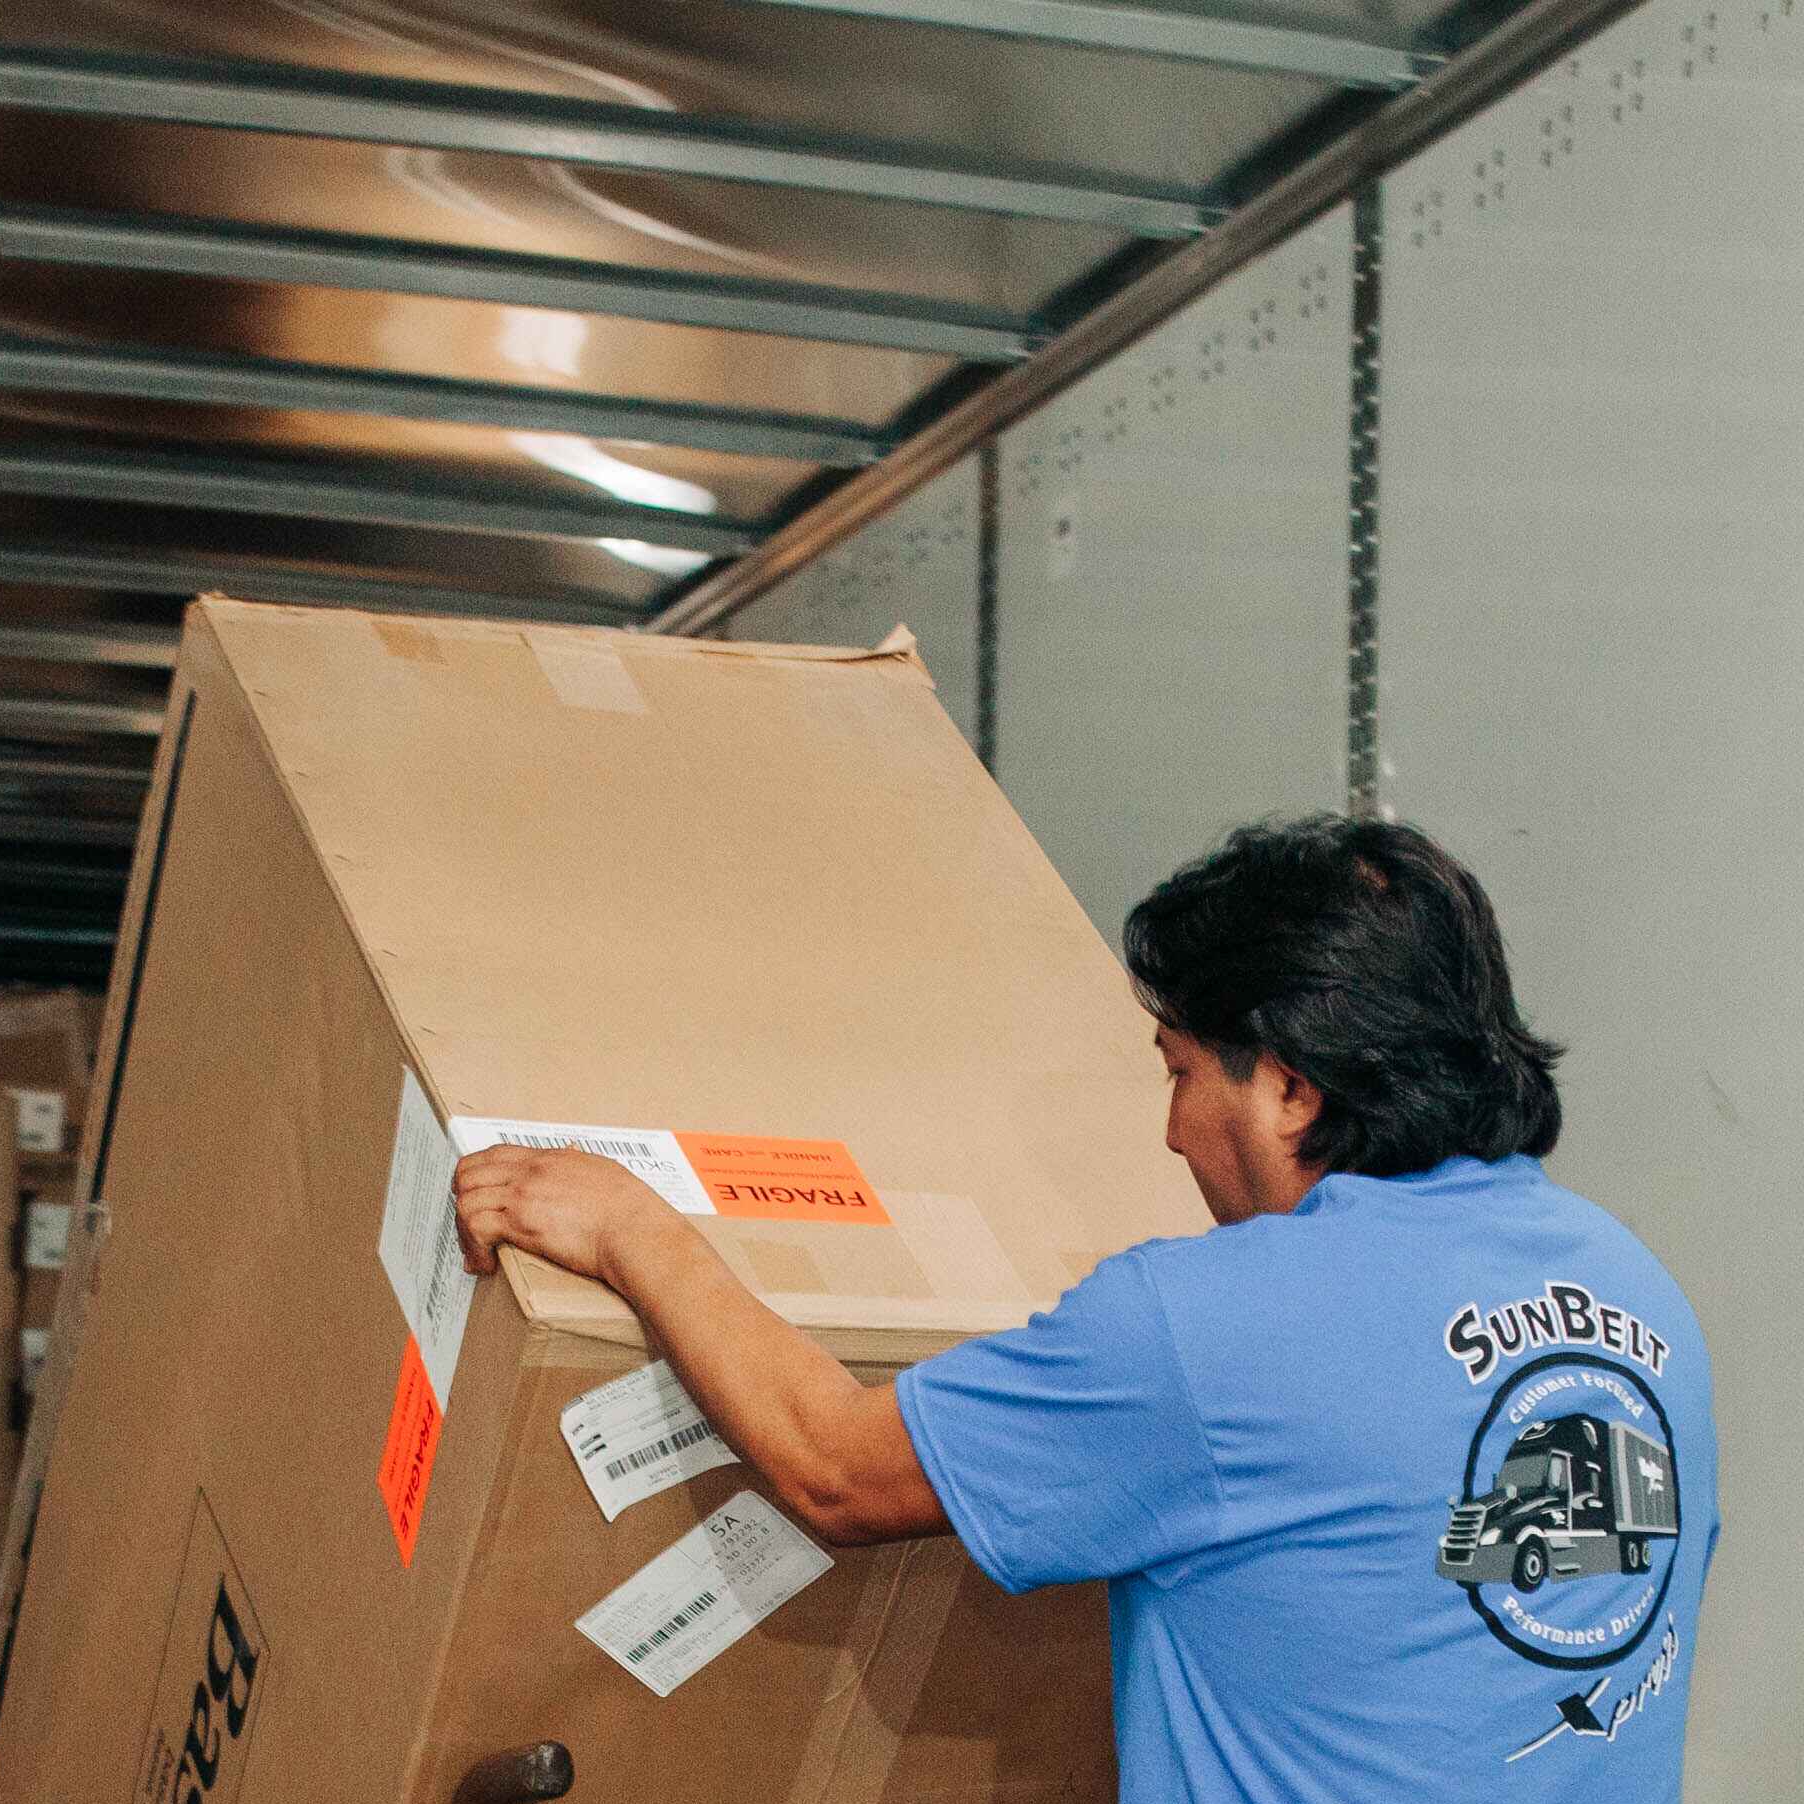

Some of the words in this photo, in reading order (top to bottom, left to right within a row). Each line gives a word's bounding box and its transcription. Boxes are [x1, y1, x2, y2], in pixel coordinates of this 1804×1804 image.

[699, 1146, 745, 1158] CARE
[769, 1151, 834, 1163] HANDLE
[716, 1182, 867, 1209] FRAGILE
[1509, 1375, 1577, 1424] Customer
[1580, 1371, 1645, 1420] Focused
[399, 1400, 436, 1540] FRAGILE
[710, 1516, 740, 1538] 5A
